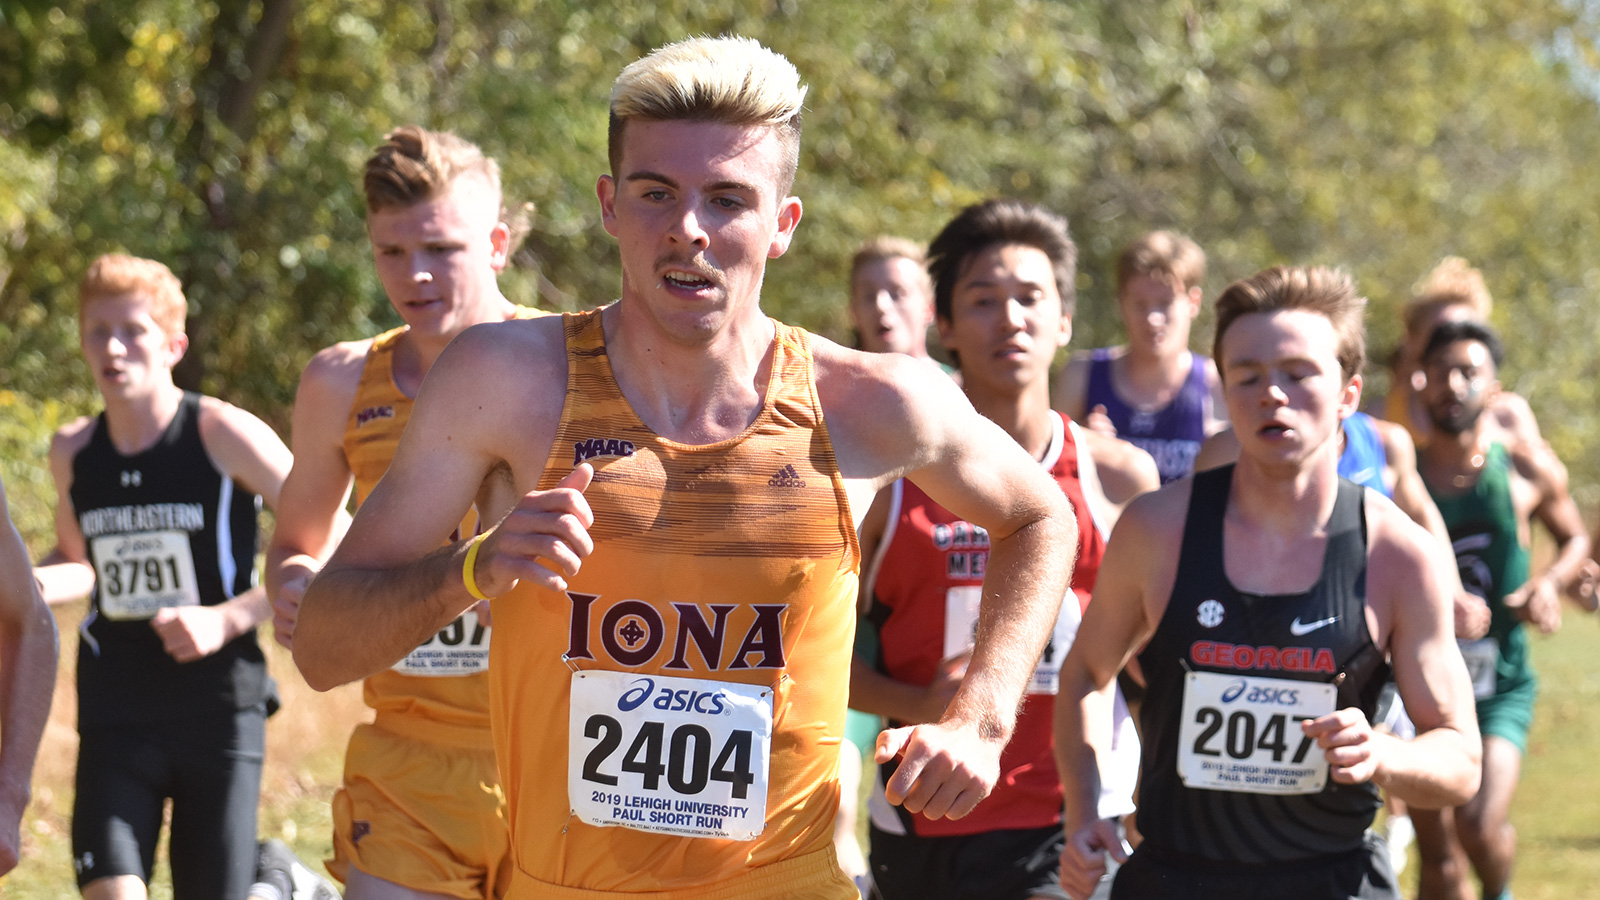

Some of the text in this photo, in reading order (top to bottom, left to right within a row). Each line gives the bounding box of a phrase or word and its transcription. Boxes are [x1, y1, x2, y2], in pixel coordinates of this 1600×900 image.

[573, 438, 636, 467] MAAC
[768, 478, 806, 489] adidas
[80, 502, 205, 538] NORTHEASTERN
[104, 555, 181, 597] 3791
[948, 552, 989, 579] ME
[564, 590, 790, 672] IONA
[1190, 640, 1337, 673] GEORGIA
[653, 687, 726, 715] asics
[1247, 686, 1300, 706] asics
[1192, 706, 1324, 765] 2047
[582, 714, 754, 799] 2404
[591, 791, 749, 819] 2019 LEHIGH UNIVERSITY
[612, 807, 723, 829] PAUL SHORT RUN
